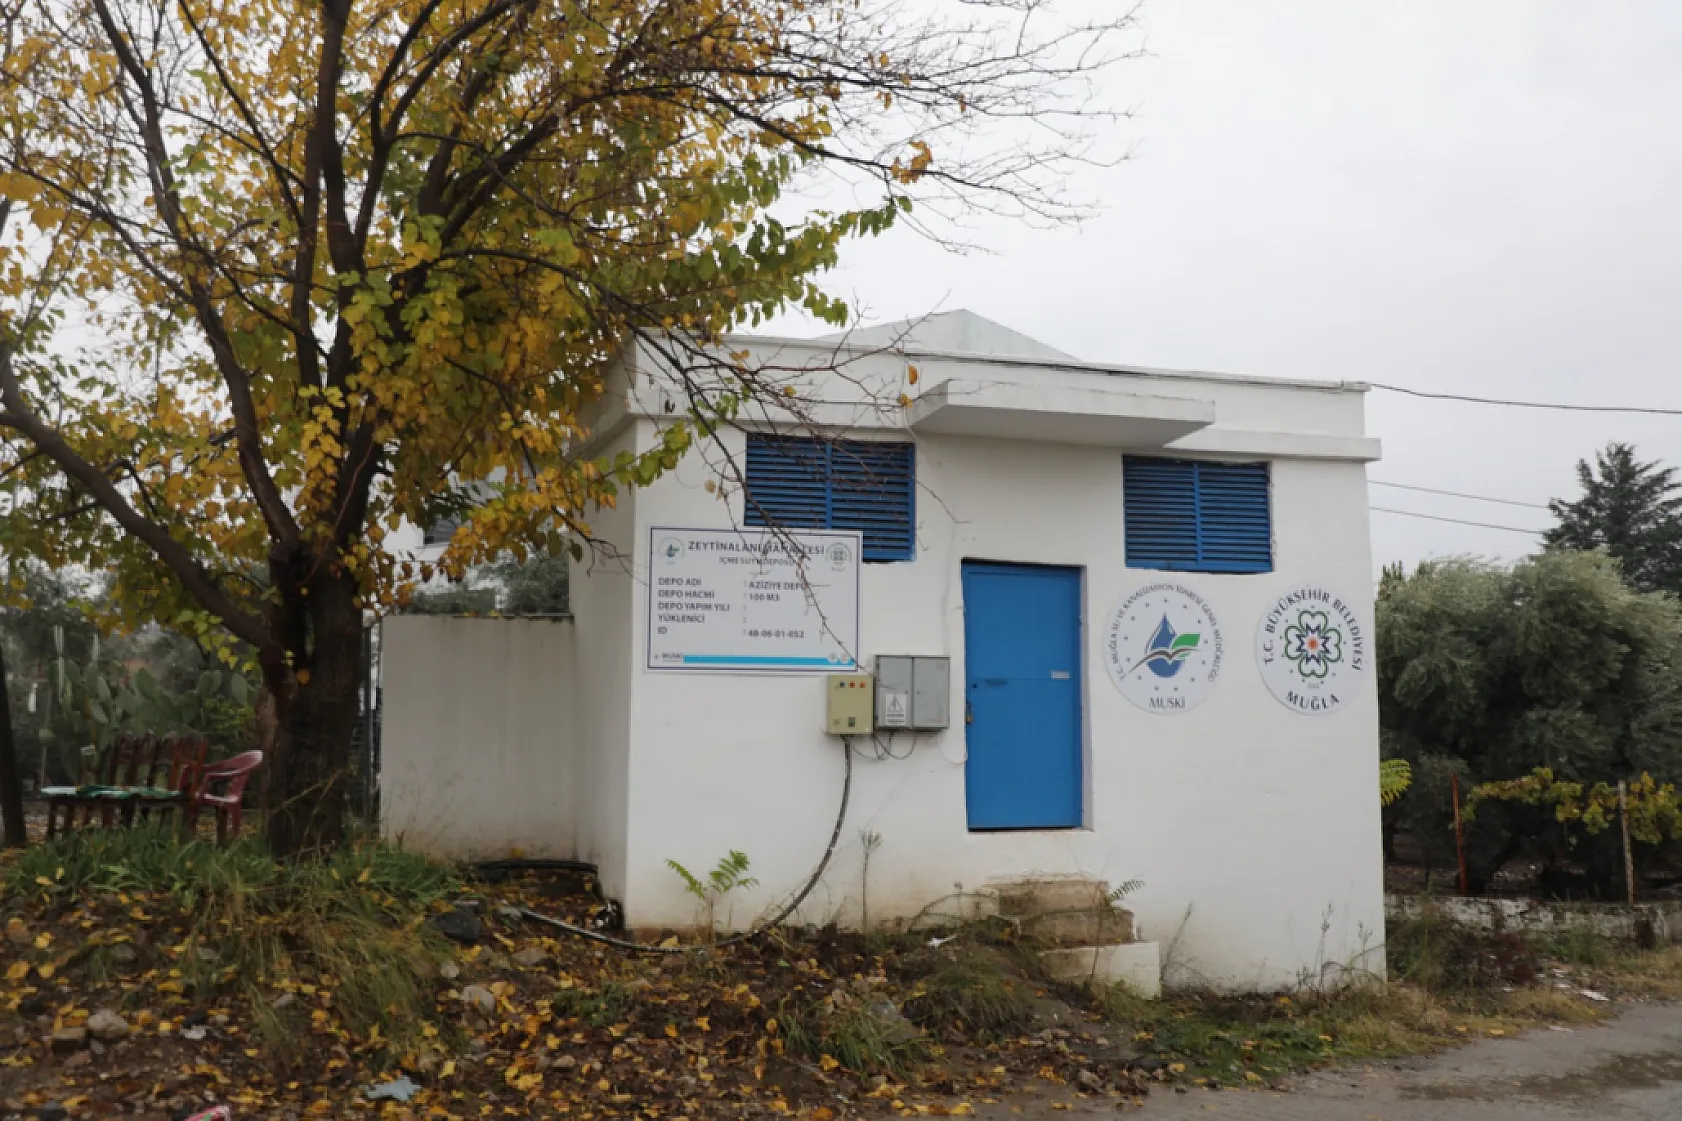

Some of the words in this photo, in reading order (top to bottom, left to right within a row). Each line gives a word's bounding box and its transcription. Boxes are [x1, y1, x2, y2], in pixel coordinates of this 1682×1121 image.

[658, 577, 684, 586] DEPO
[685, 578, 702, 586] ADI
[658, 589, 684, 598] DEPO
[749, 593, 766, 601] 100
[658, 602, 684, 610] DEPO
[684, 602, 712, 611] YAPIM
[1287, 690, 1340, 710] MUĞLA
